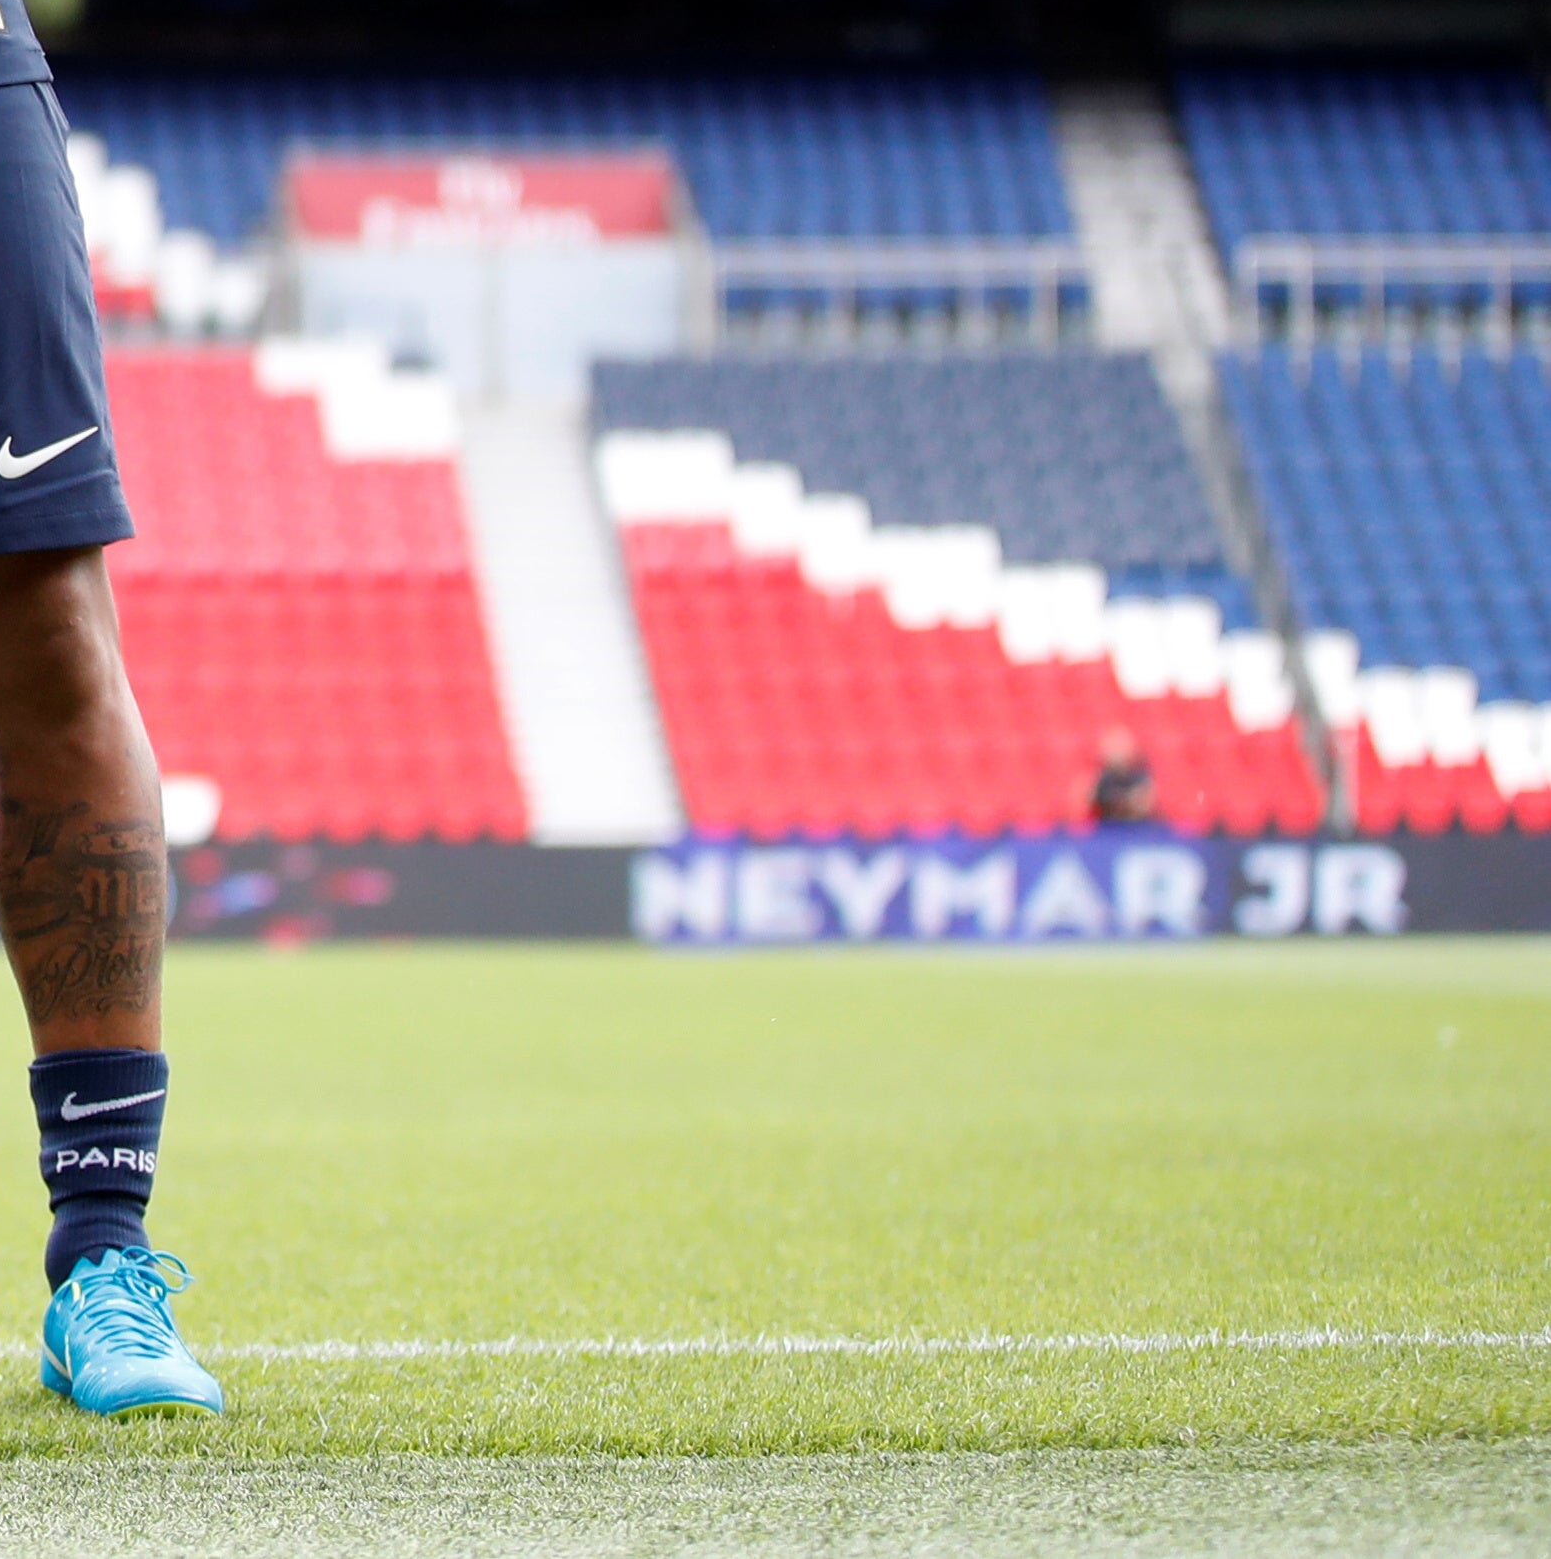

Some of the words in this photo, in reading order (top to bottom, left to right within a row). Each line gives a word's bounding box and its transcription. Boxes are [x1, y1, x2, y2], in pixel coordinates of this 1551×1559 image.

[629, 845, 1208, 939] NEYMAR
[1234, 845, 1407, 937] JR
[56, 1146, 156, 1174] PARIS
